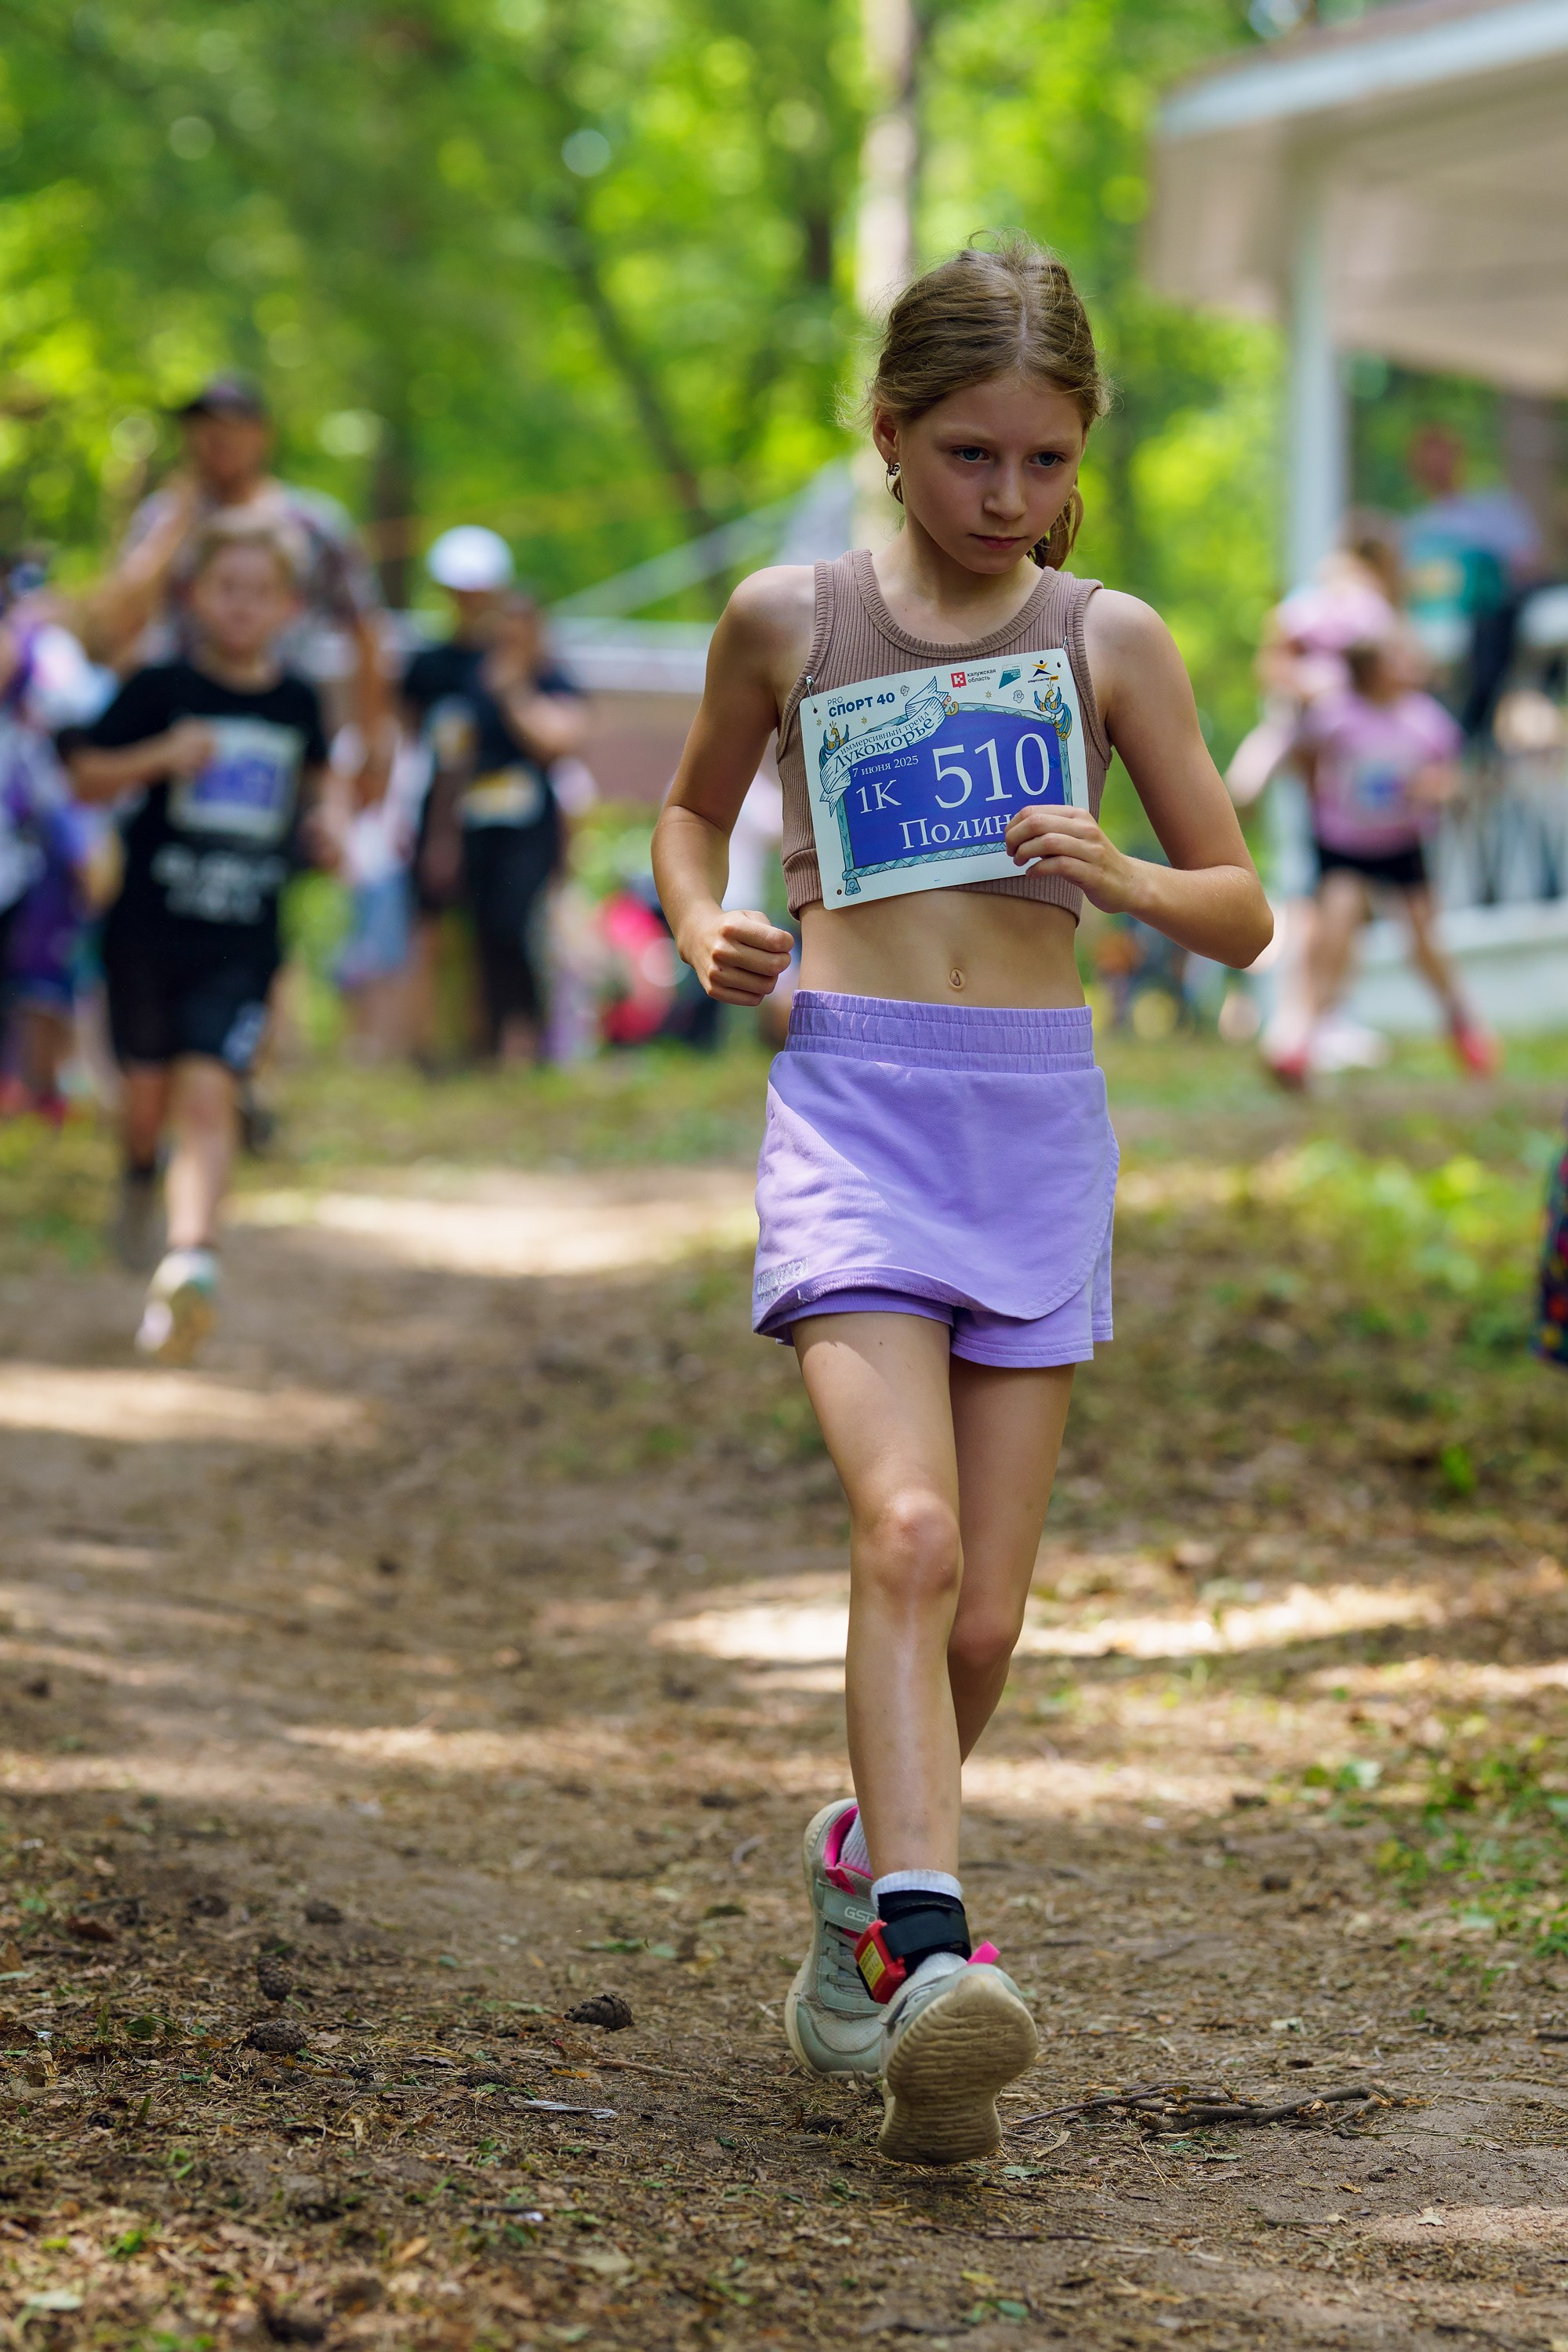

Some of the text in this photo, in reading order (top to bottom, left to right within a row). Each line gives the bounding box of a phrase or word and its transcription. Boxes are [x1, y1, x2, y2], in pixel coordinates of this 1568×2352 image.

[967, 669, 996, 677] калужская
[827, 696, 844, 706] PRO
[829, 692, 895, 717] СПОРТ 40
[834, 717, 935, 774] Лукоморье
[840, 711, 930, 755] иммерсивный трейл
[852, 755, 919, 778] 7 июня 2025
[855, 733, 1051, 814] 1К 510
[898, 813, 1011, 850] Полин
